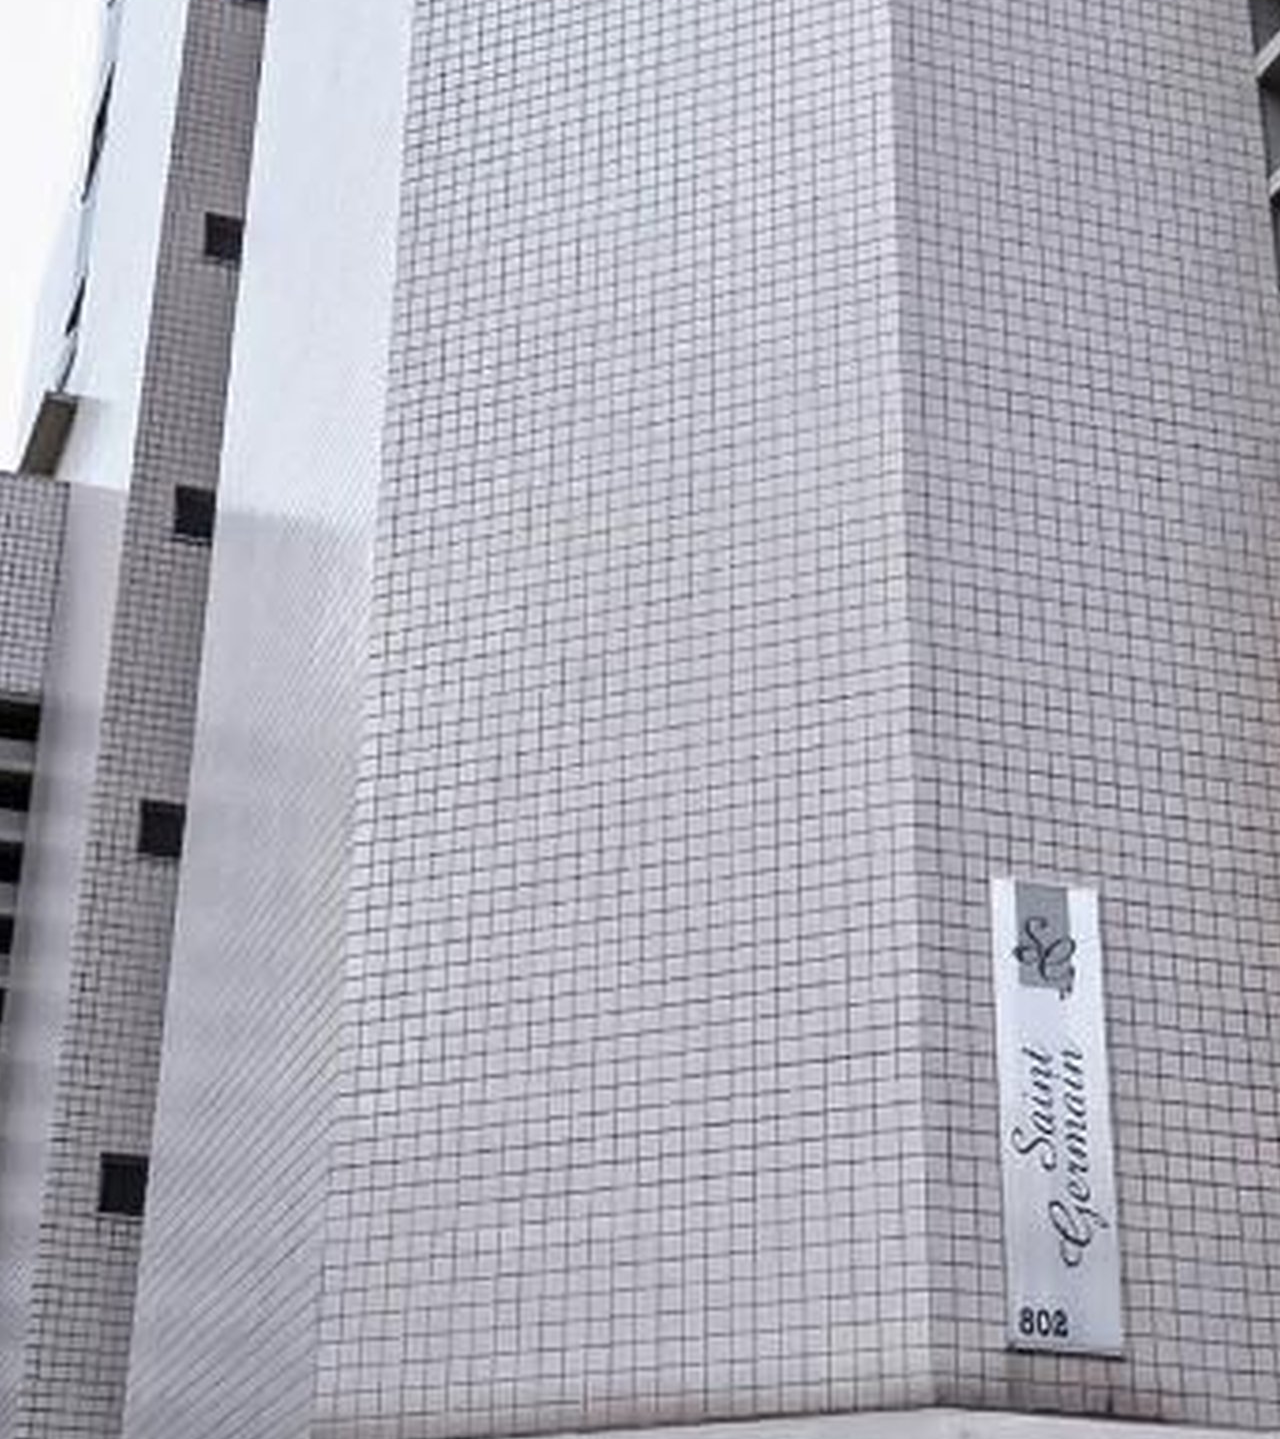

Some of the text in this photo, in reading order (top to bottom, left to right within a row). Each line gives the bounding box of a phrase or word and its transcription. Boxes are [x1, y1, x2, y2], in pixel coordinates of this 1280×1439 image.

[1011, 1046, 1058, 1171] Saint
[1048, 1050, 1109, 1268] Germain
[1019, 1306, 1069, 1339] 802
